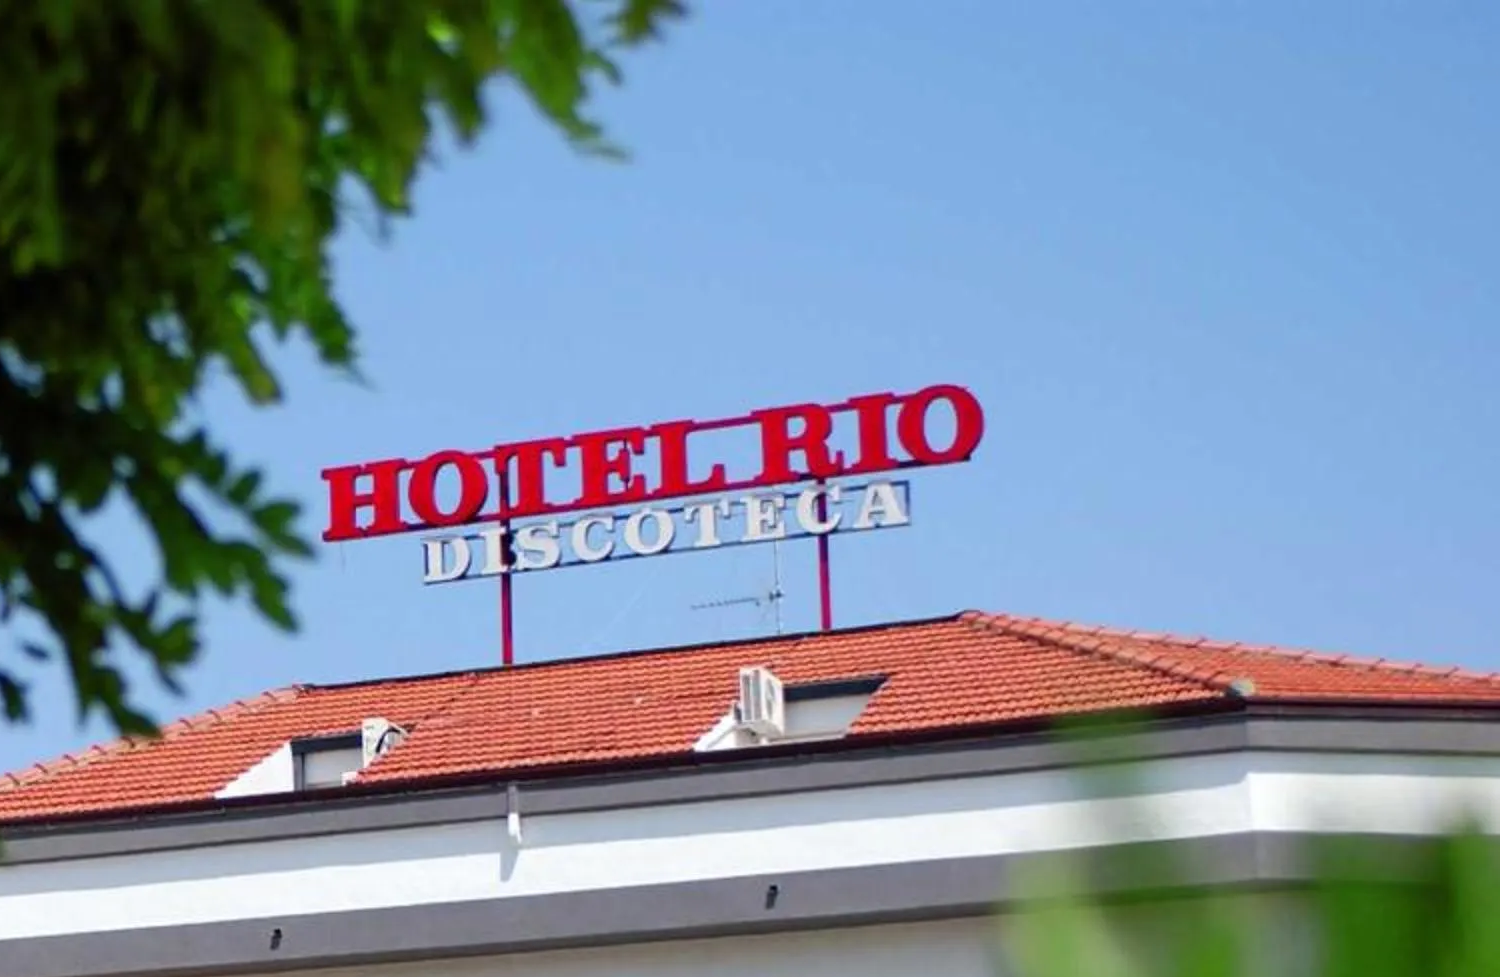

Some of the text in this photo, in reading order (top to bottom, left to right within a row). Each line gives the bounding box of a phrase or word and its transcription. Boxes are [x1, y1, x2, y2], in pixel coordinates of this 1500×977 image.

[321, 384, 985, 542] HOTEL RIO
[422, 479, 910, 585] DISCOTECA
